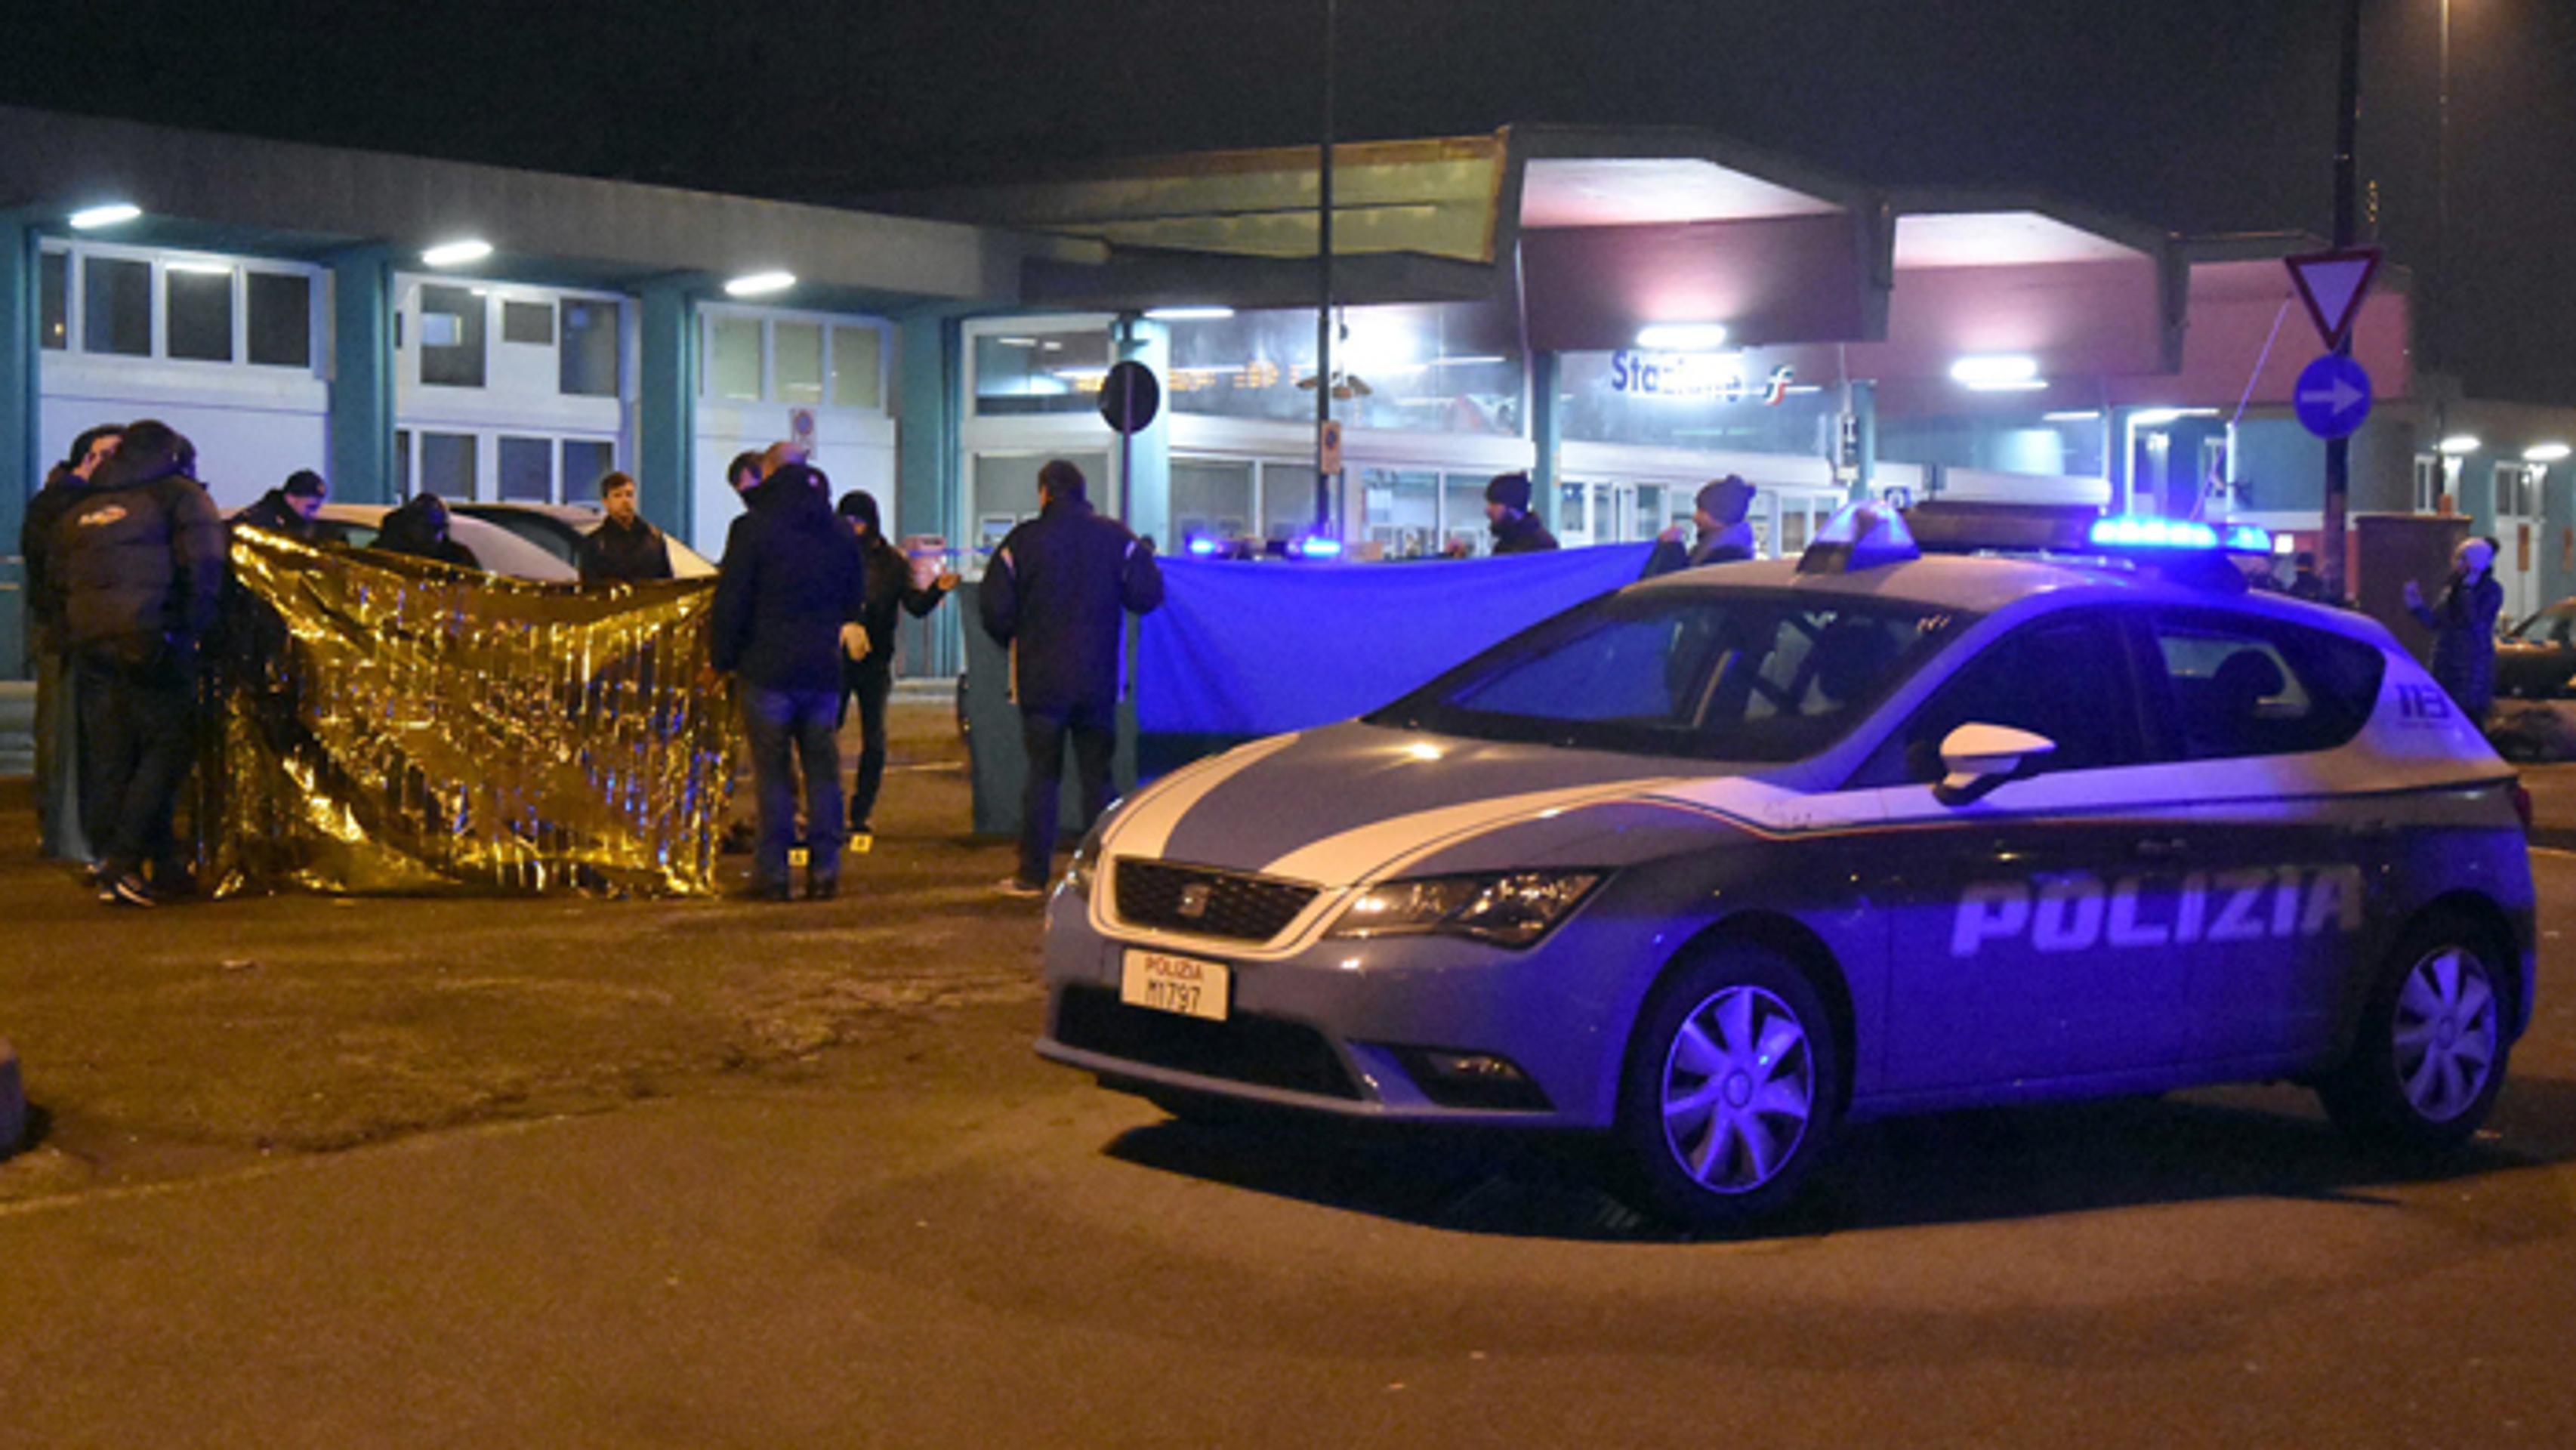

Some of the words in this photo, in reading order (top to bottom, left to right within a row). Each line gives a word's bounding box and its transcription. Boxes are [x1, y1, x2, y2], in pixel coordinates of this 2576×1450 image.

[1612, 350, 1741, 403] Stae
[2396, 683, 2450, 719] 113
[1950, 865, 2362, 958] POLIZIA
[1145, 954, 1203, 981] POLIZIA
